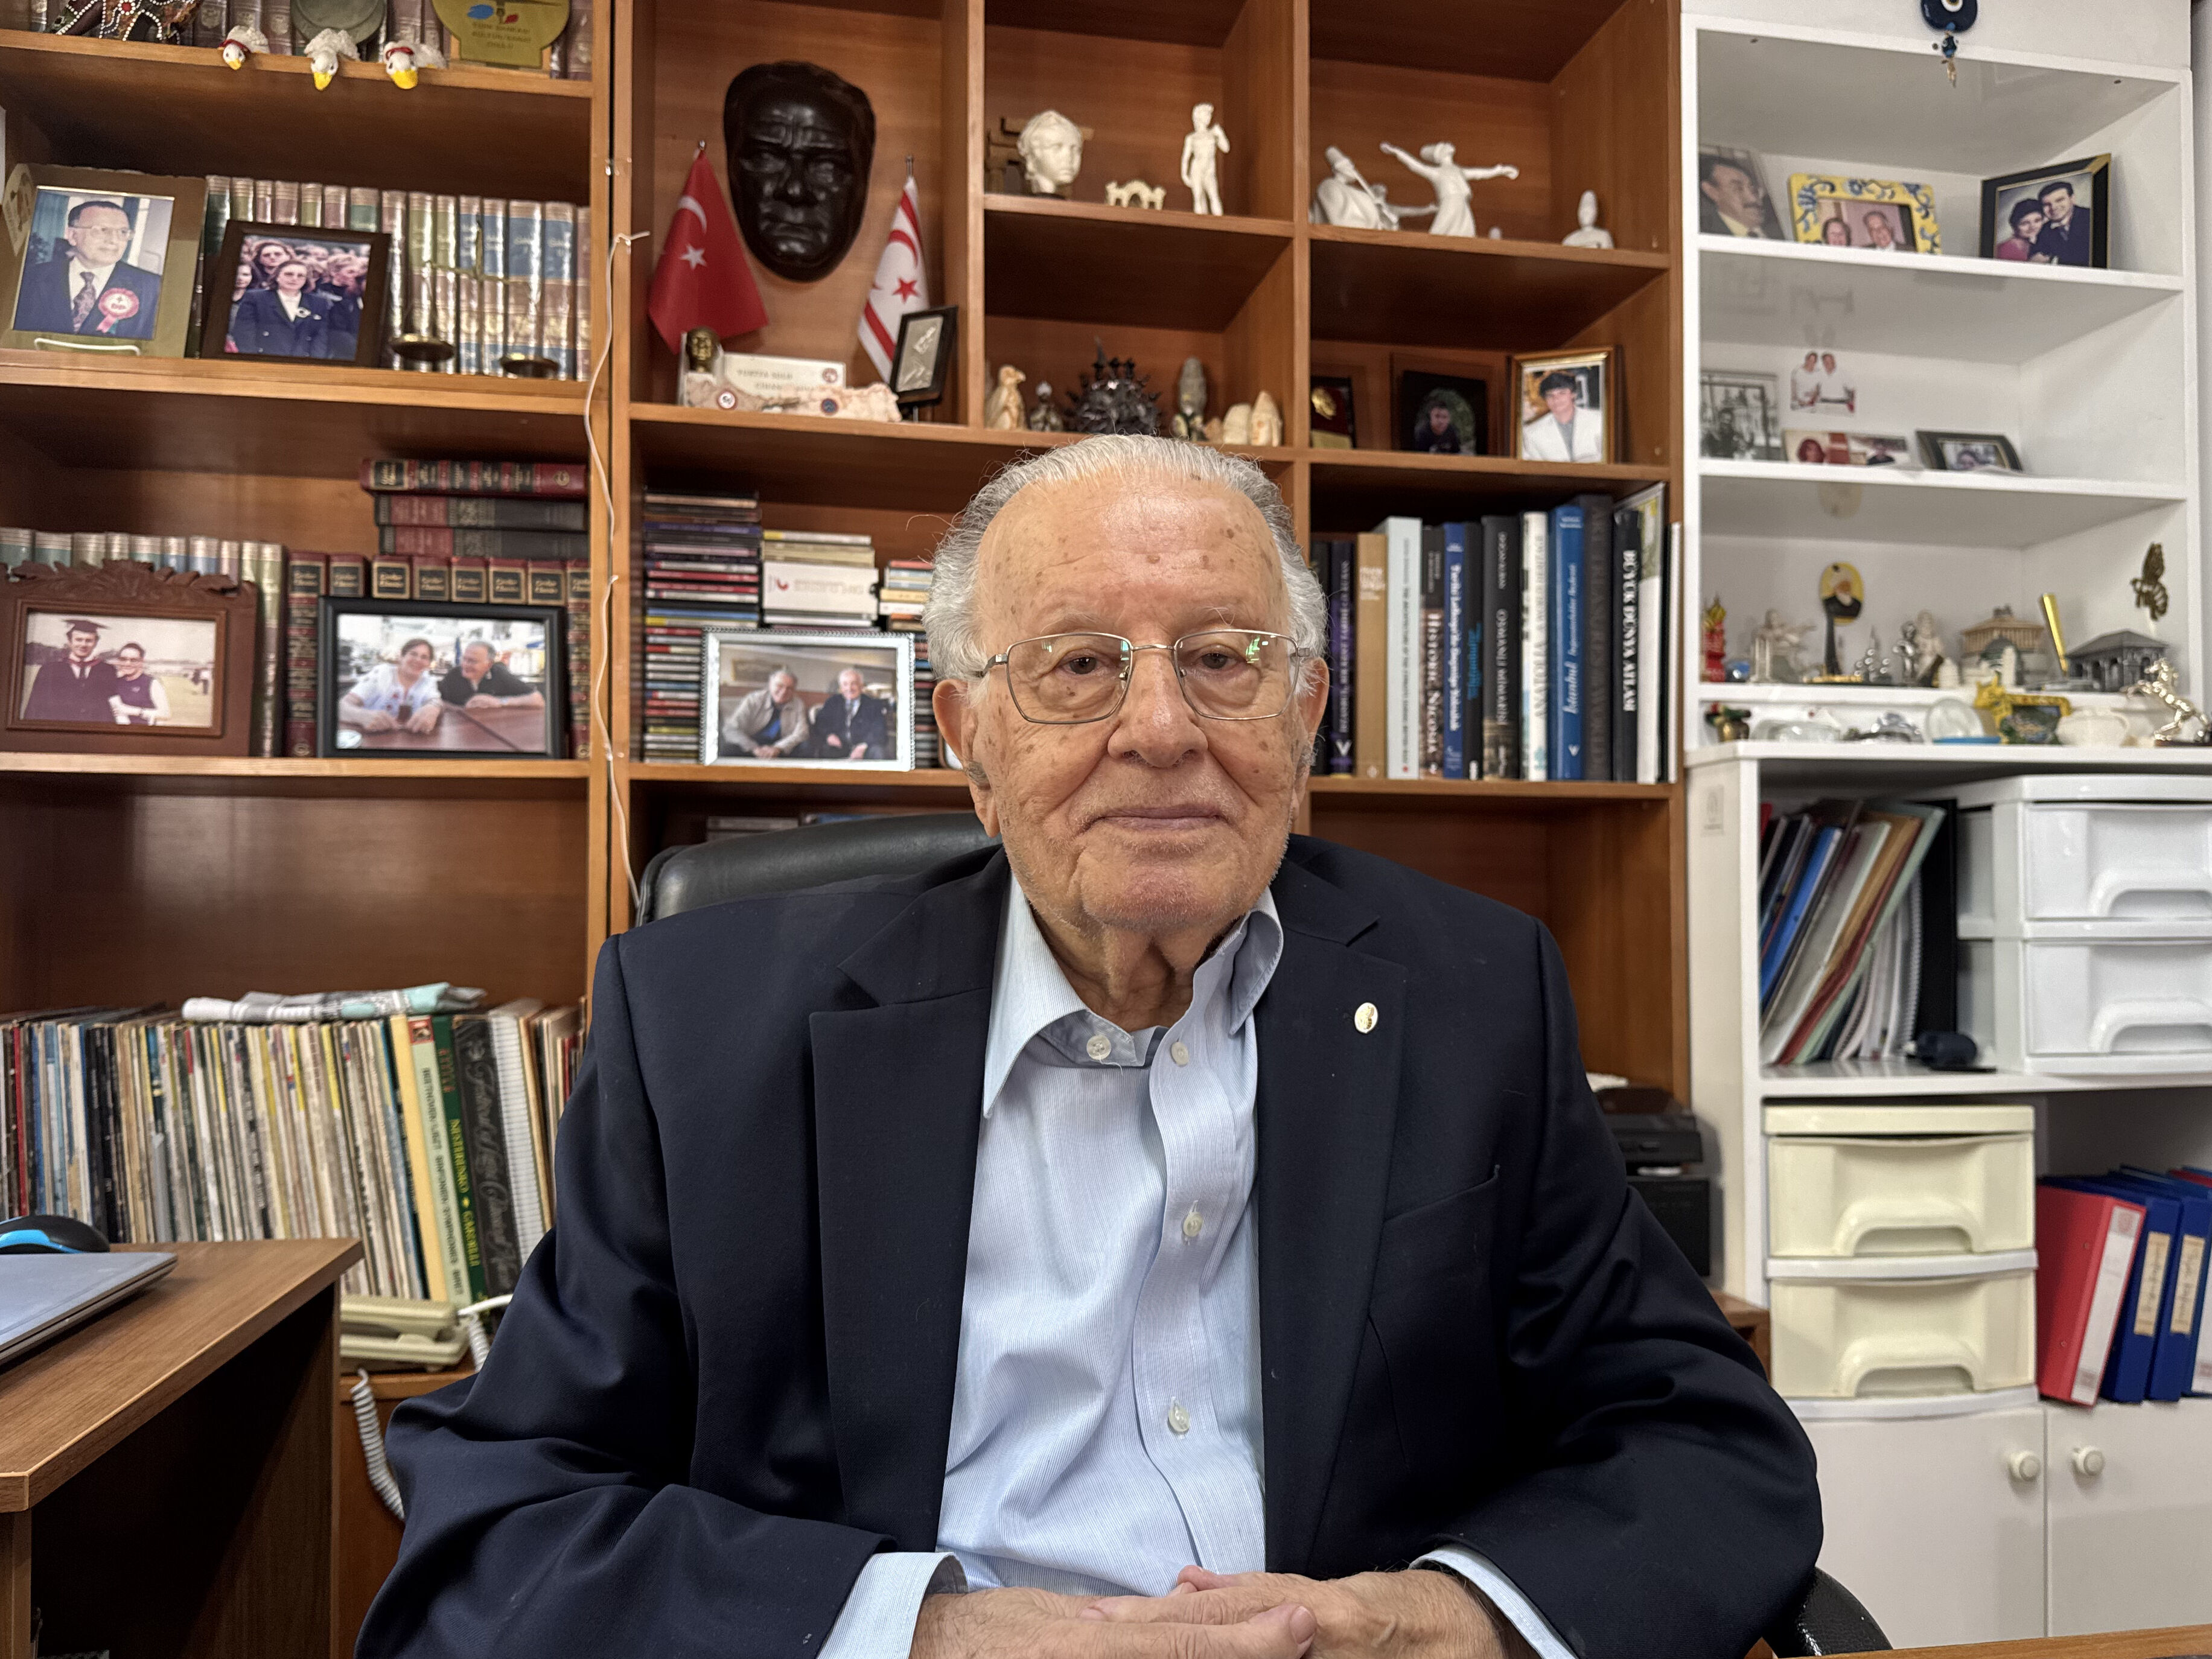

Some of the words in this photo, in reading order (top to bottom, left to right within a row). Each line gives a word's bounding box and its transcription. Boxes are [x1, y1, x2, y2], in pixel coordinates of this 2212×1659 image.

[1622, 549, 1637, 604] BÜYÜK
[1622, 605, 1637, 659] DÜNYA
[1622, 660, 1637, 712] ATLASI
